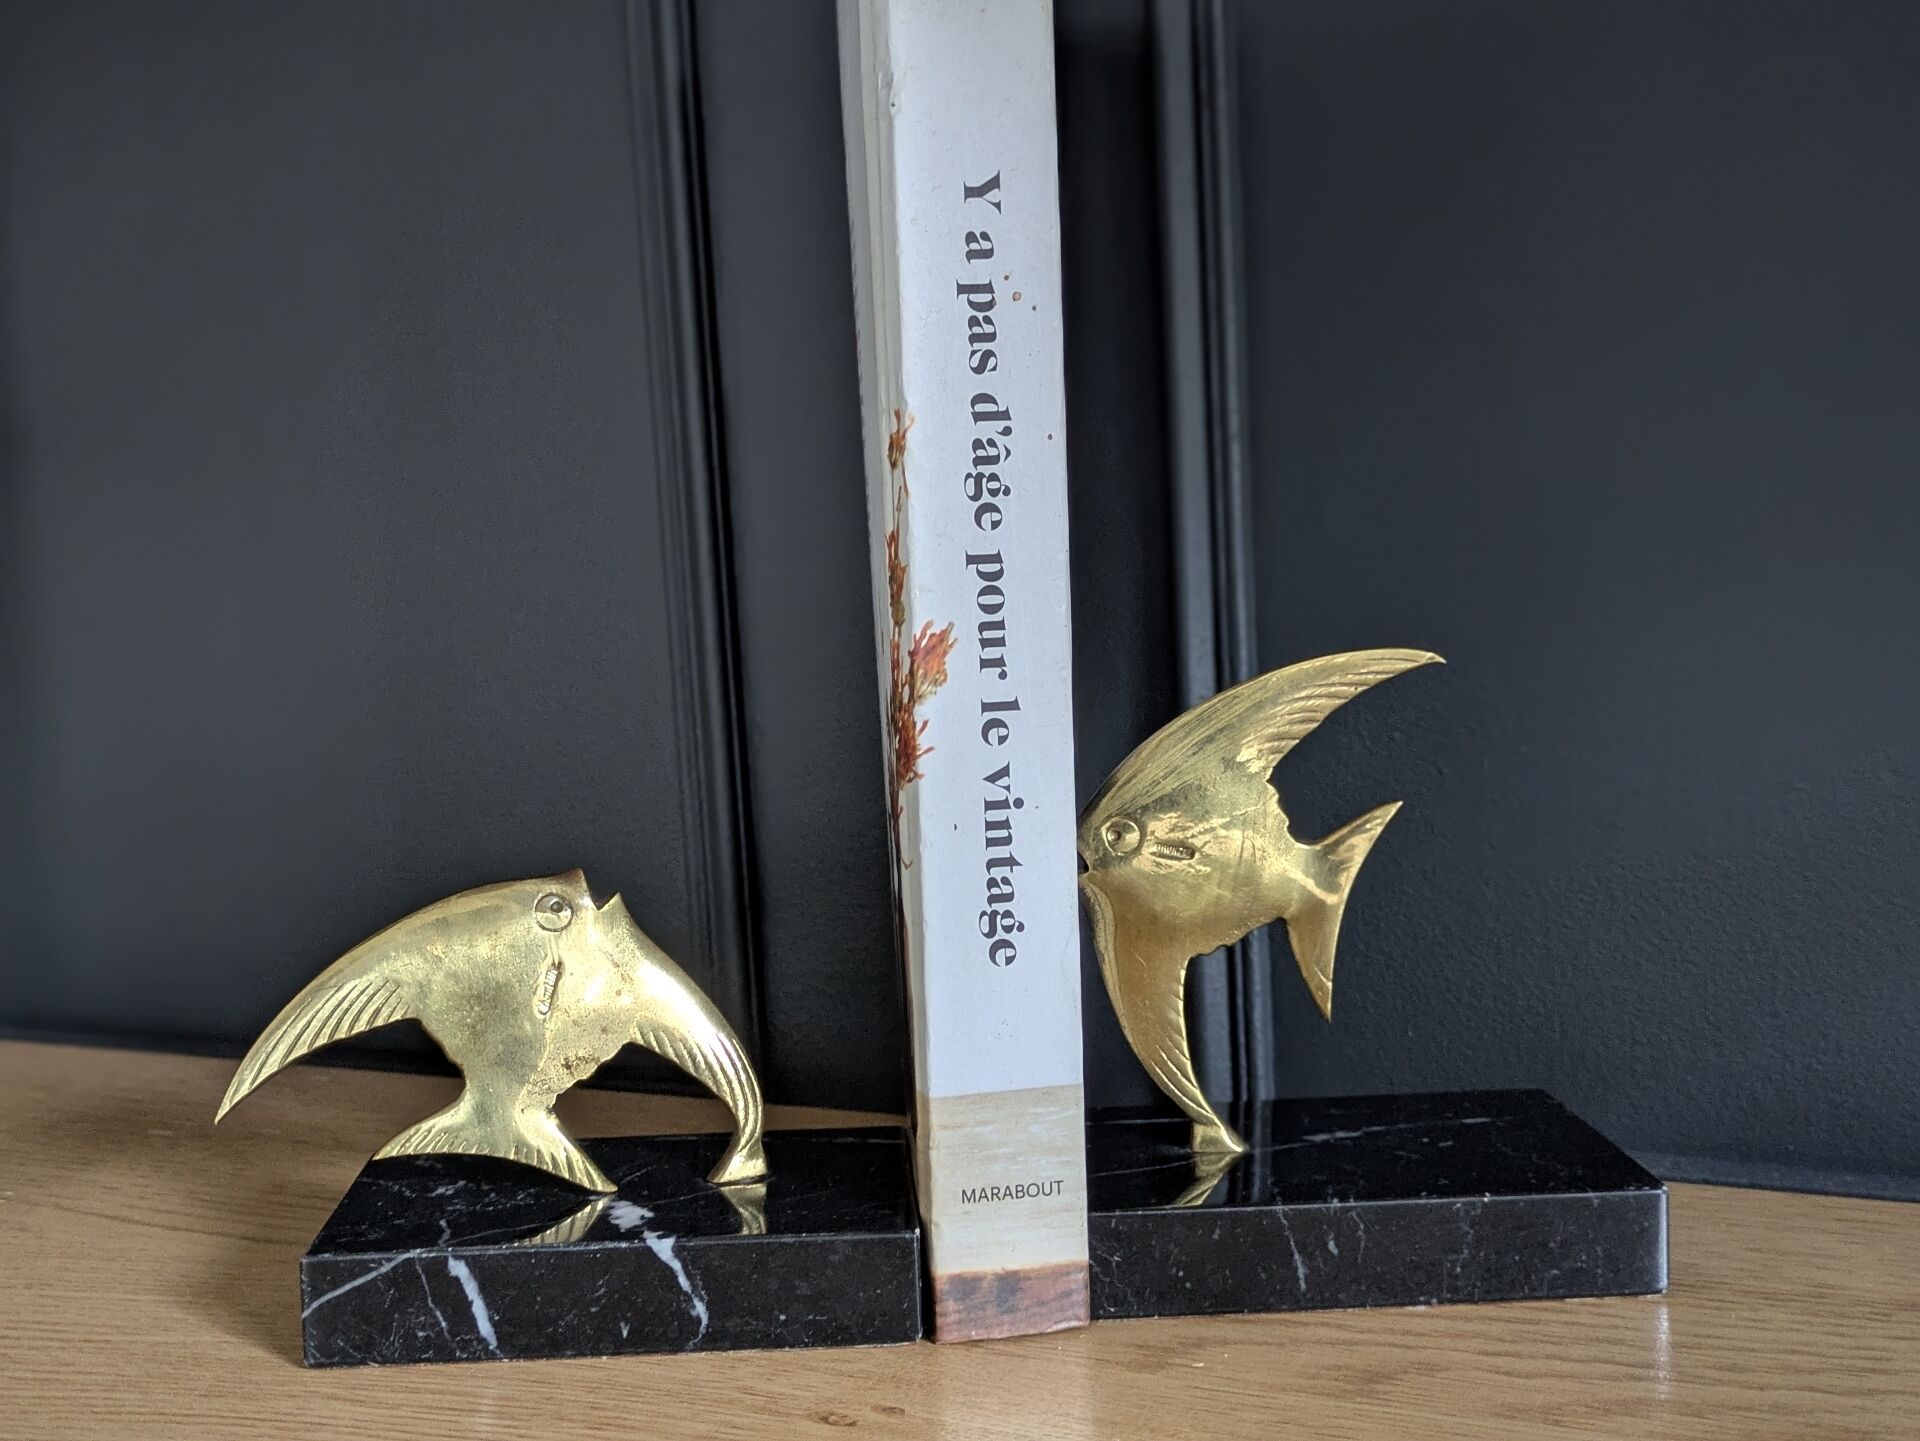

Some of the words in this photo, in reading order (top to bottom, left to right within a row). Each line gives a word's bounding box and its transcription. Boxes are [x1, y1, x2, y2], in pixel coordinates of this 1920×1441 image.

[963, 170, 1002, 215] Y
[964, 230, 993, 264] a
[956, 278, 998, 375] pas
[963, 392, 1013, 531] d'âge
[964, 549, 1008, 681] pour
[980, 696, 1021, 747] le
[977, 761, 1025, 968] vintage
[961, 1180, 1064, 1204] MARABOUT
